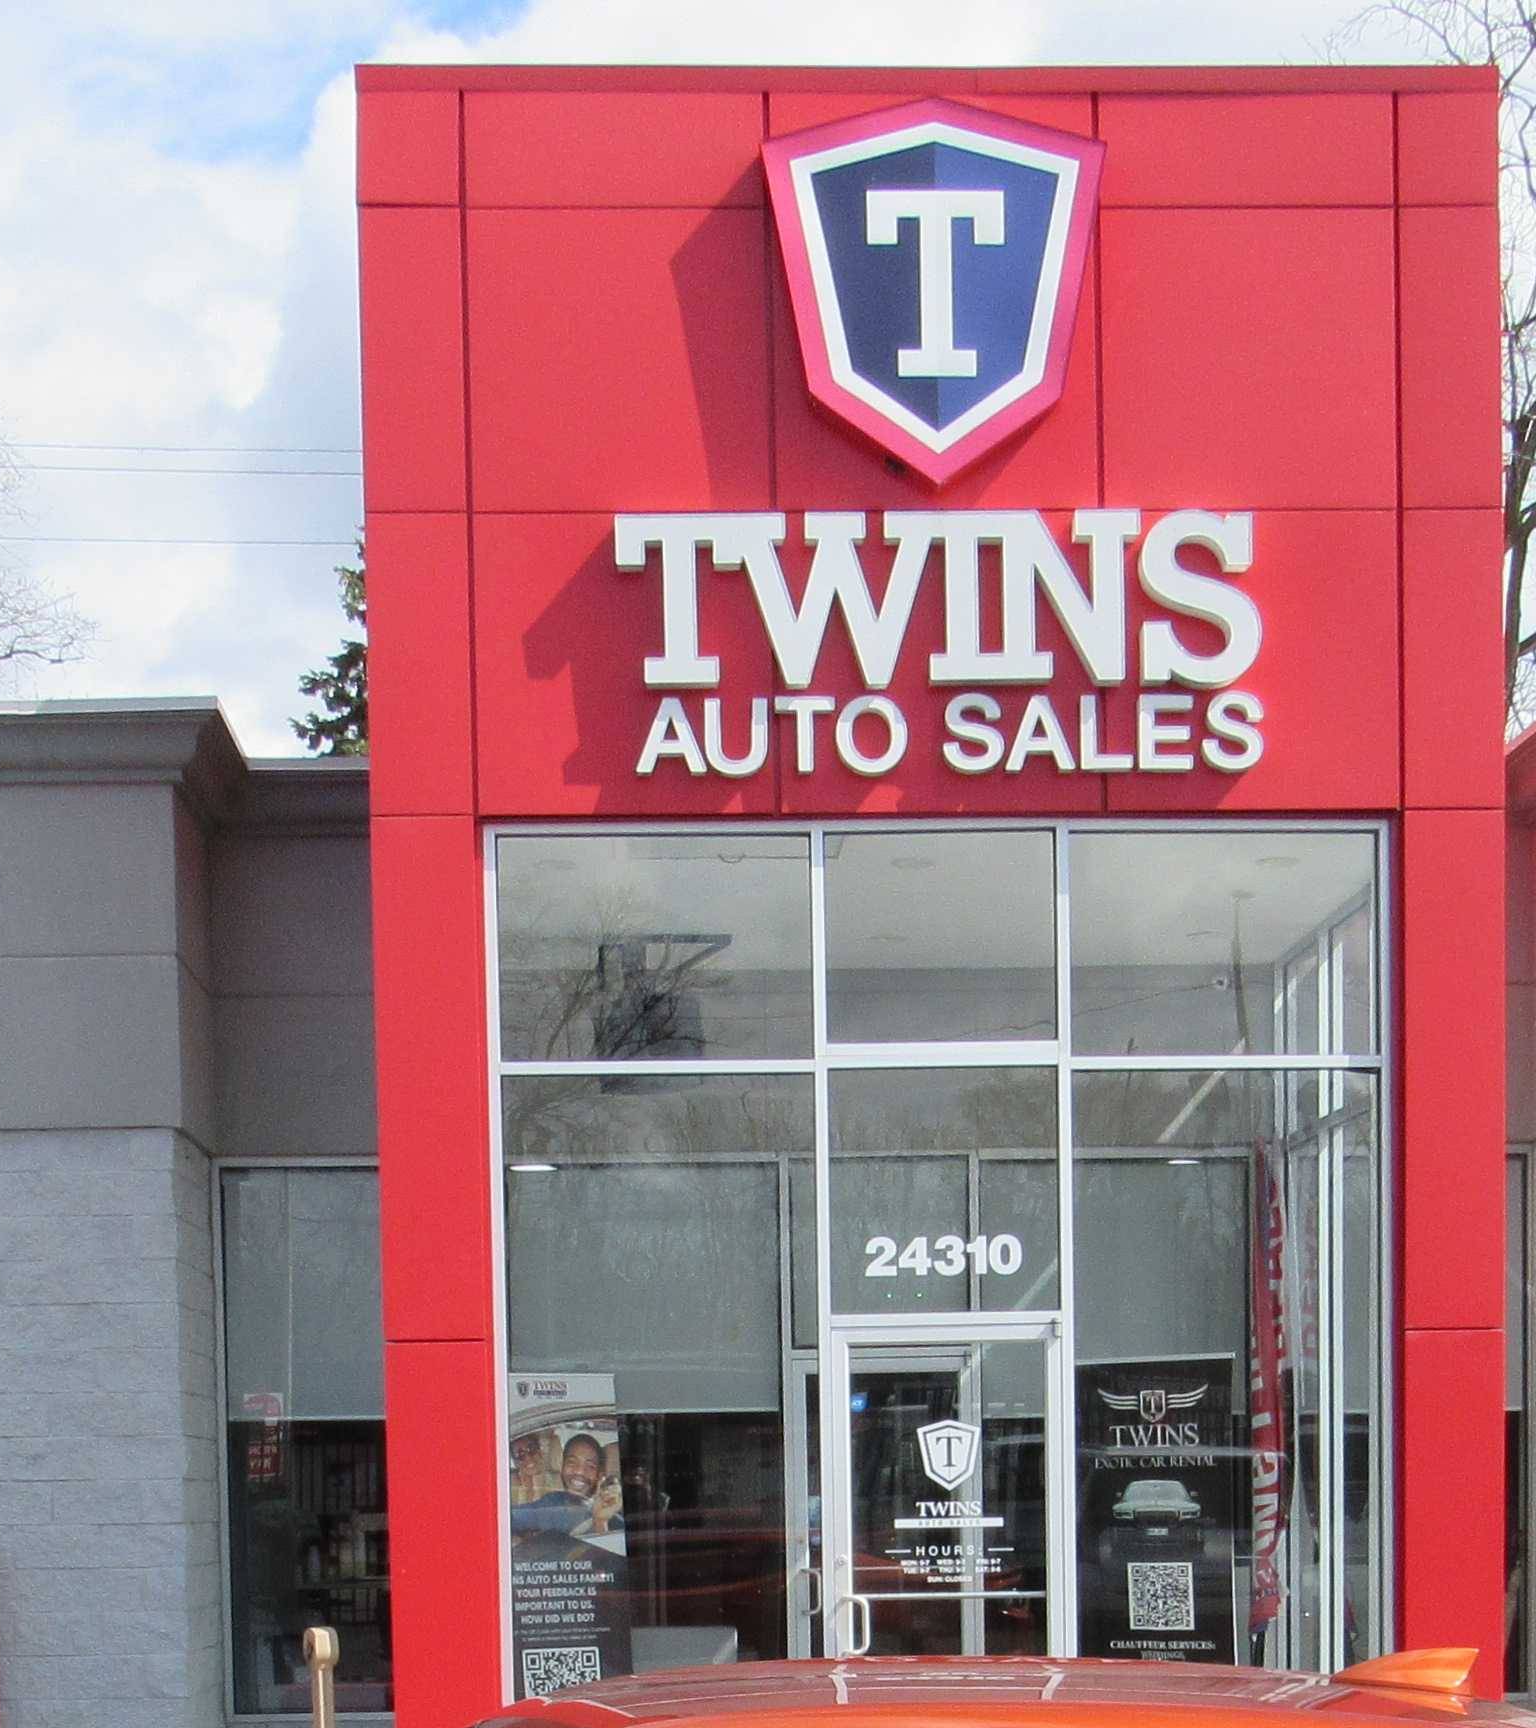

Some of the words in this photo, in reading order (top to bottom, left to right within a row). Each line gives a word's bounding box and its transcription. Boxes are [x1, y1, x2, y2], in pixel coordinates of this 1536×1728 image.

[866, 189, 1005, 377] T
[614, 509, 1263, 690] TWINS
[635, 695, 909, 777] AUTO
[942, 693, 1265, 775] SALES
[864, 1233, 1023, 1277] 24310
[1109, 1423, 1200, 1449] TWINS
[935, 1436, 963, 1467] T
[1139, 1455, 1166, 1468] CAR
[1169, 1454, 1217, 1468] RENTAL
[915, 1501, 982, 1517] TWINS
[513, 1561, 559, 1571] WELCOME
[560, 1561, 572, 1570] TO
[573, 1560, 593, 1570] OUR
[526, 1575, 551, 1585] AUTO
[552, 1573, 579, 1584] SALES
[517, 1588, 542, 1598] YOUR
[542, 1587, 586, 1598] FEEDBACK
[587, 1586, 597, 1596] IS
[514, 1601, 565, 1611] IMPORTANT
[567, 1600, 580, 1609] TO
[520, 1615, 544, 1625] HOW
[544, 1614, 561, 1624] DID
[561, 1614, 576, 1623] WE
[576, 1612, 596, 1622] DO?
